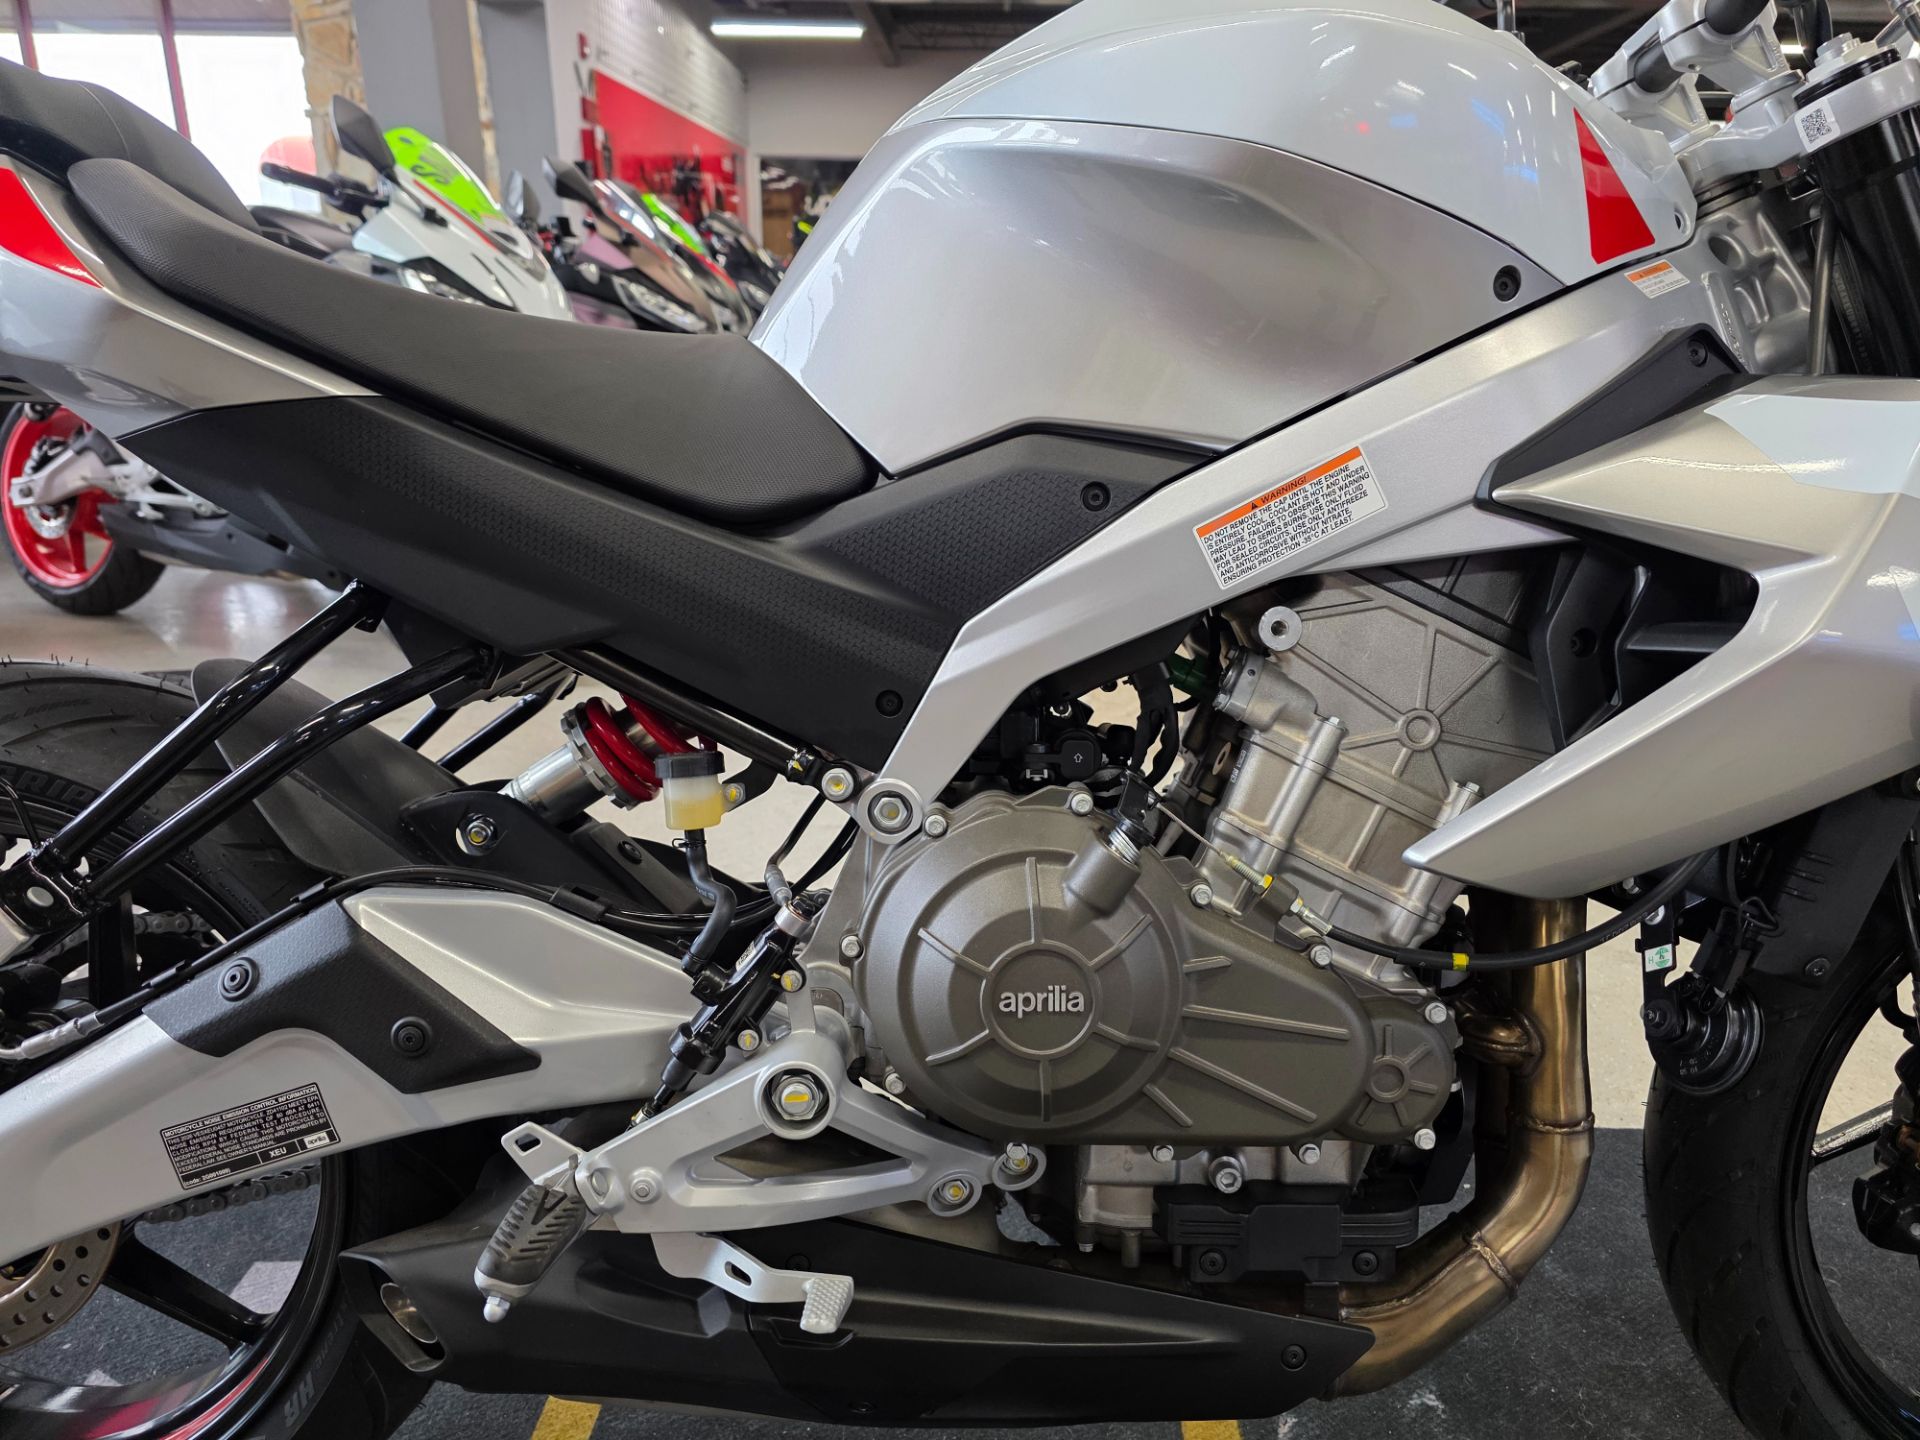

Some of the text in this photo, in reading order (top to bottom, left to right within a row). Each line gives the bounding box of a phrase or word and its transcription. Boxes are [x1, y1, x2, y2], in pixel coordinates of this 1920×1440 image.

[1203, 464, 1349, 543] DO NOT REMOVE THE CAP UNTIL THE ENGINE
[1207, 465, 1364, 550] IS ENTIRELY COOL. COOLANT IS HOT AND UNDER
[1209, 471, 1368, 557] PRESSURE. FAILURE TO OBSERVE THIS WARNING
[1261, 476, 1305, 504] WARNING!
[1213, 482, 1363, 564] MAY LEAD TO SERIUS BURNS. USE ONLY FLUID
[1216, 489, 1367, 571] FOR SEALED CIRCUITS. USE ONLY ANTIFREEZE
[1219, 565, 1234, 577] AND
[1234, 538, 1288, 570] ANTICORROSIVE
[1289, 522, 1320, 542] WITHOUT
[1222, 562, 1257, 584] ENSURING
[1257, 540, 1300, 567] PROTECTION
[1320, 525, 1329, 535] AT
[1330, 513, 1353, 530] LEAST.
[999, 985, 1084, 1019] aprilia
[164, 1086, 317, 1137] MOTORCYCLE NOISE EMISSION CONTROL INFORMATION
[287, 1098, 306, 1108] MEETS
[306, 1094, 318, 1102] EPA
[169, 1141, 187, 1151] NOISE
[189, 1132, 217, 1145] EMISSION
[218, 1117, 263, 1136] REQUIREMENTS
[172, 1143, 200, 1156] CLOSING
[201, 1138, 217, 1147] RPM
[229, 1125, 259, 1138] FEDERAL
[262, 1119, 278, 1128] TEST
[174, 1144, 217, 1162] MODIFICATIONS
[218, 1138, 237, 1148] WHICH
[239, 1131, 258, 1142] CAUSE
[260, 1126, 274, 1135] THIS
[275, 1114, 314, 1130] MOTORCYCLE
[176, 1156, 199, 1167] EXCEED
[198, 1149, 223, 1160] FEDERAL
[223, 1143, 241, 1153] NOISE
[241, 1133, 274, 1147] STANDARDS
[273, 1129, 286, 1137] ARE
[285, 1119, 319, 1133] PROHIBITED
[268, 1146, 287, 1157] XEU
[178, 1161, 203, 1173] FEDERAL
[215, 1153, 227, 1161] SEE
